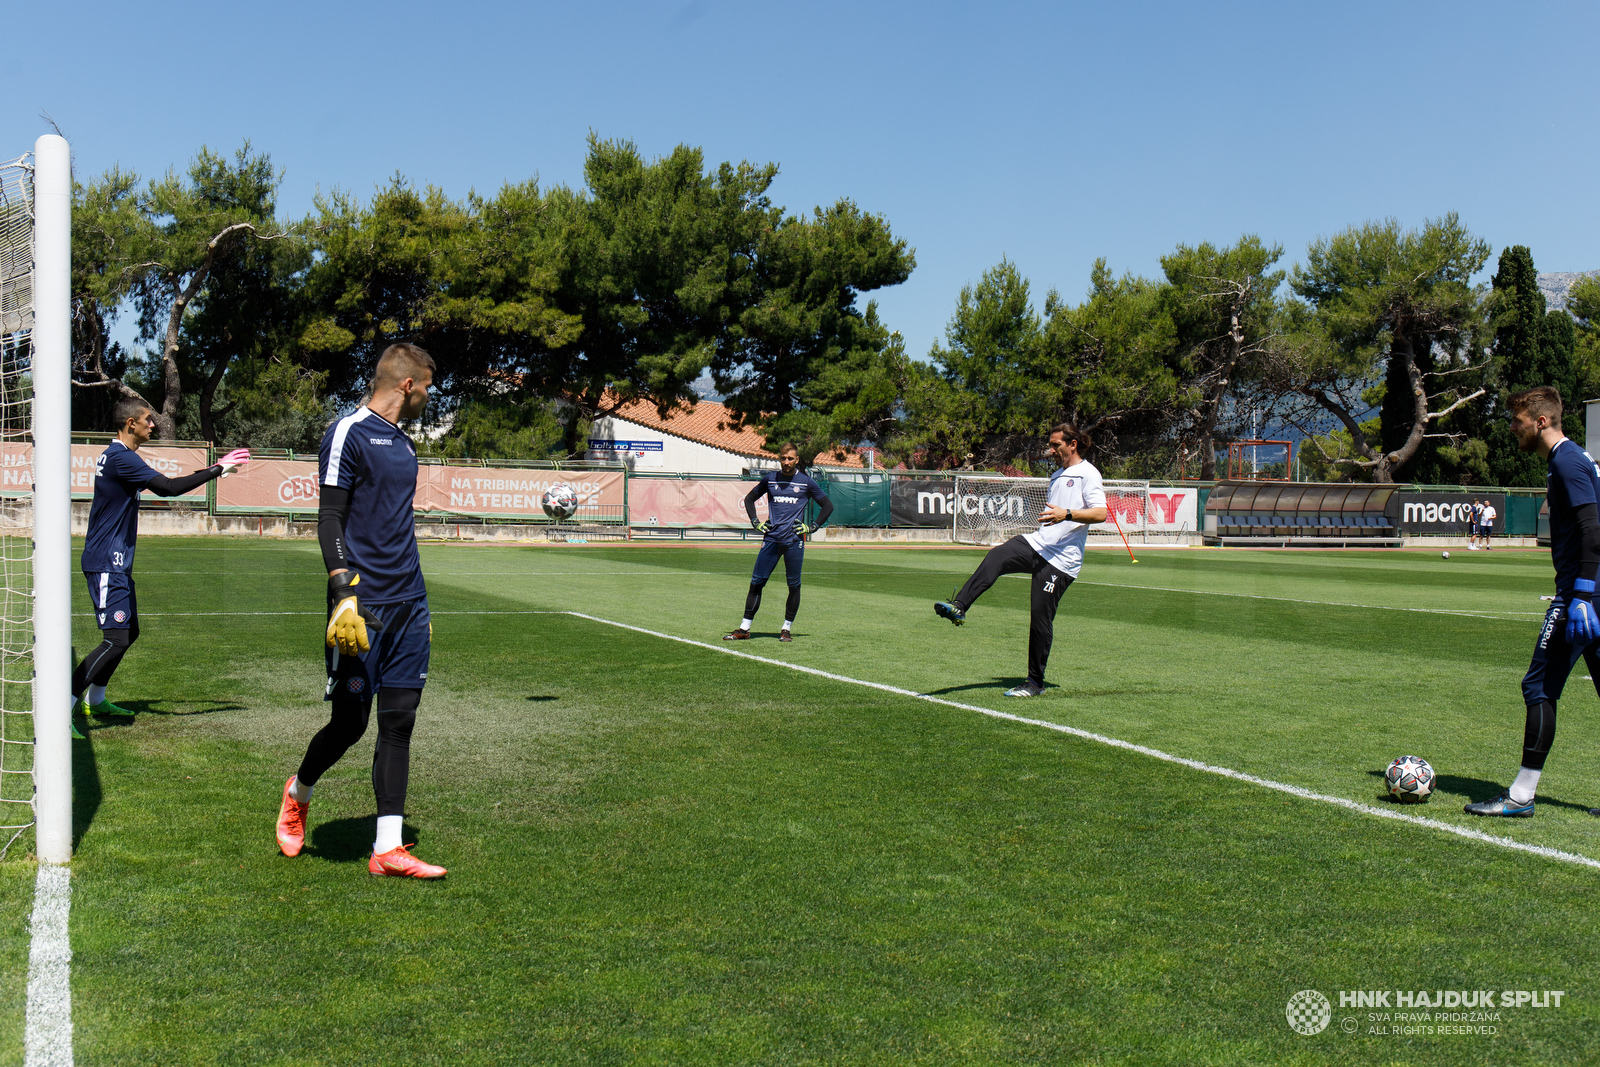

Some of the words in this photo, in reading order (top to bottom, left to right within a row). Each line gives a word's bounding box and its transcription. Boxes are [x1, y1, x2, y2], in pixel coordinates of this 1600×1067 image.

[370, 438, 393, 446] macron
[452, 478, 472, 490] NA
[474, 479, 549, 492] TRIBINAMA
[450, 492, 476, 507] NA
[773, 496, 798, 504] TOMMY
[918, 492, 1024, 516] macron
[336, 538, 344, 559] KIPSTA
[113, 552, 124, 566] 33
[1043, 581, 1055, 594] ZR
[1540, 608, 1560, 649] macron
